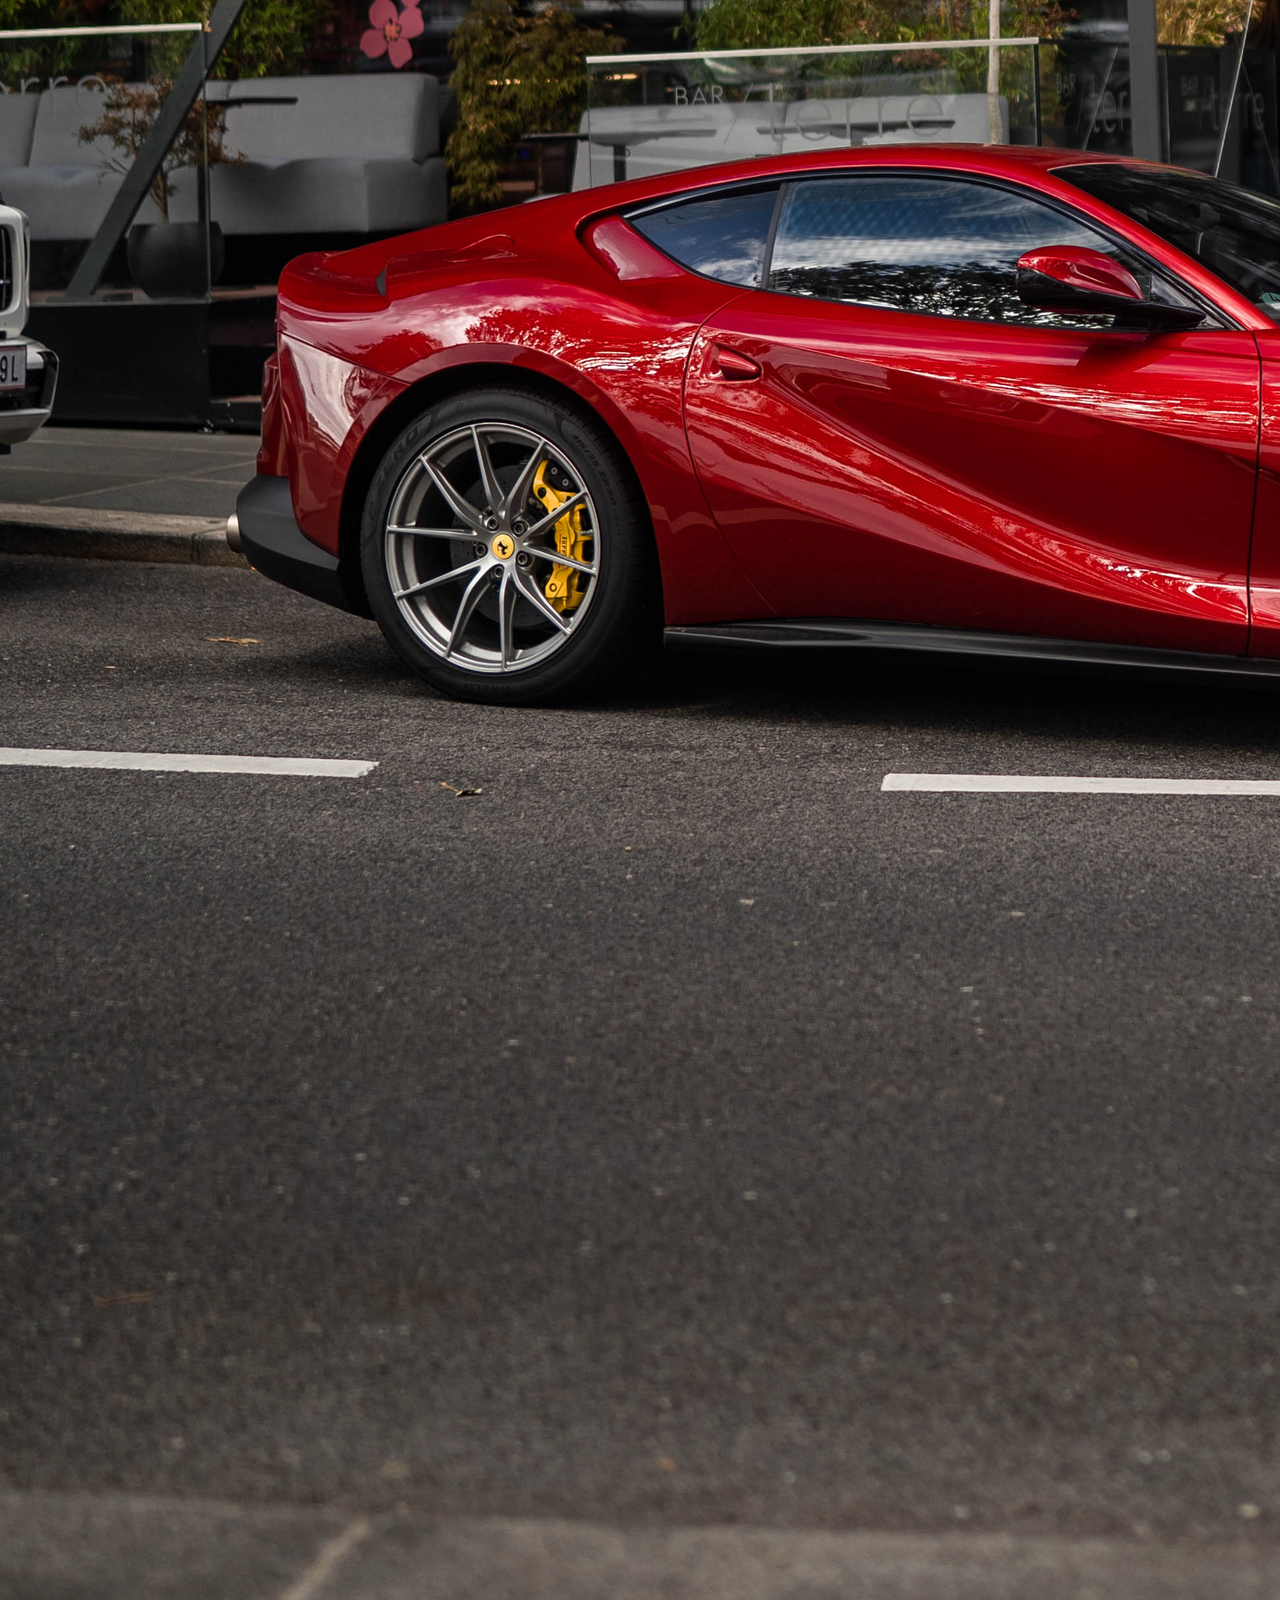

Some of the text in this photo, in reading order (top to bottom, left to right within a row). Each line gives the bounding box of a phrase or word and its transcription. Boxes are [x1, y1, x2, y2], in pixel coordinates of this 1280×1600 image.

[1056, 72, 1077, 94] BAR
[675, 85, 724, 106] BAR
[769, 83, 944, 143] terre
